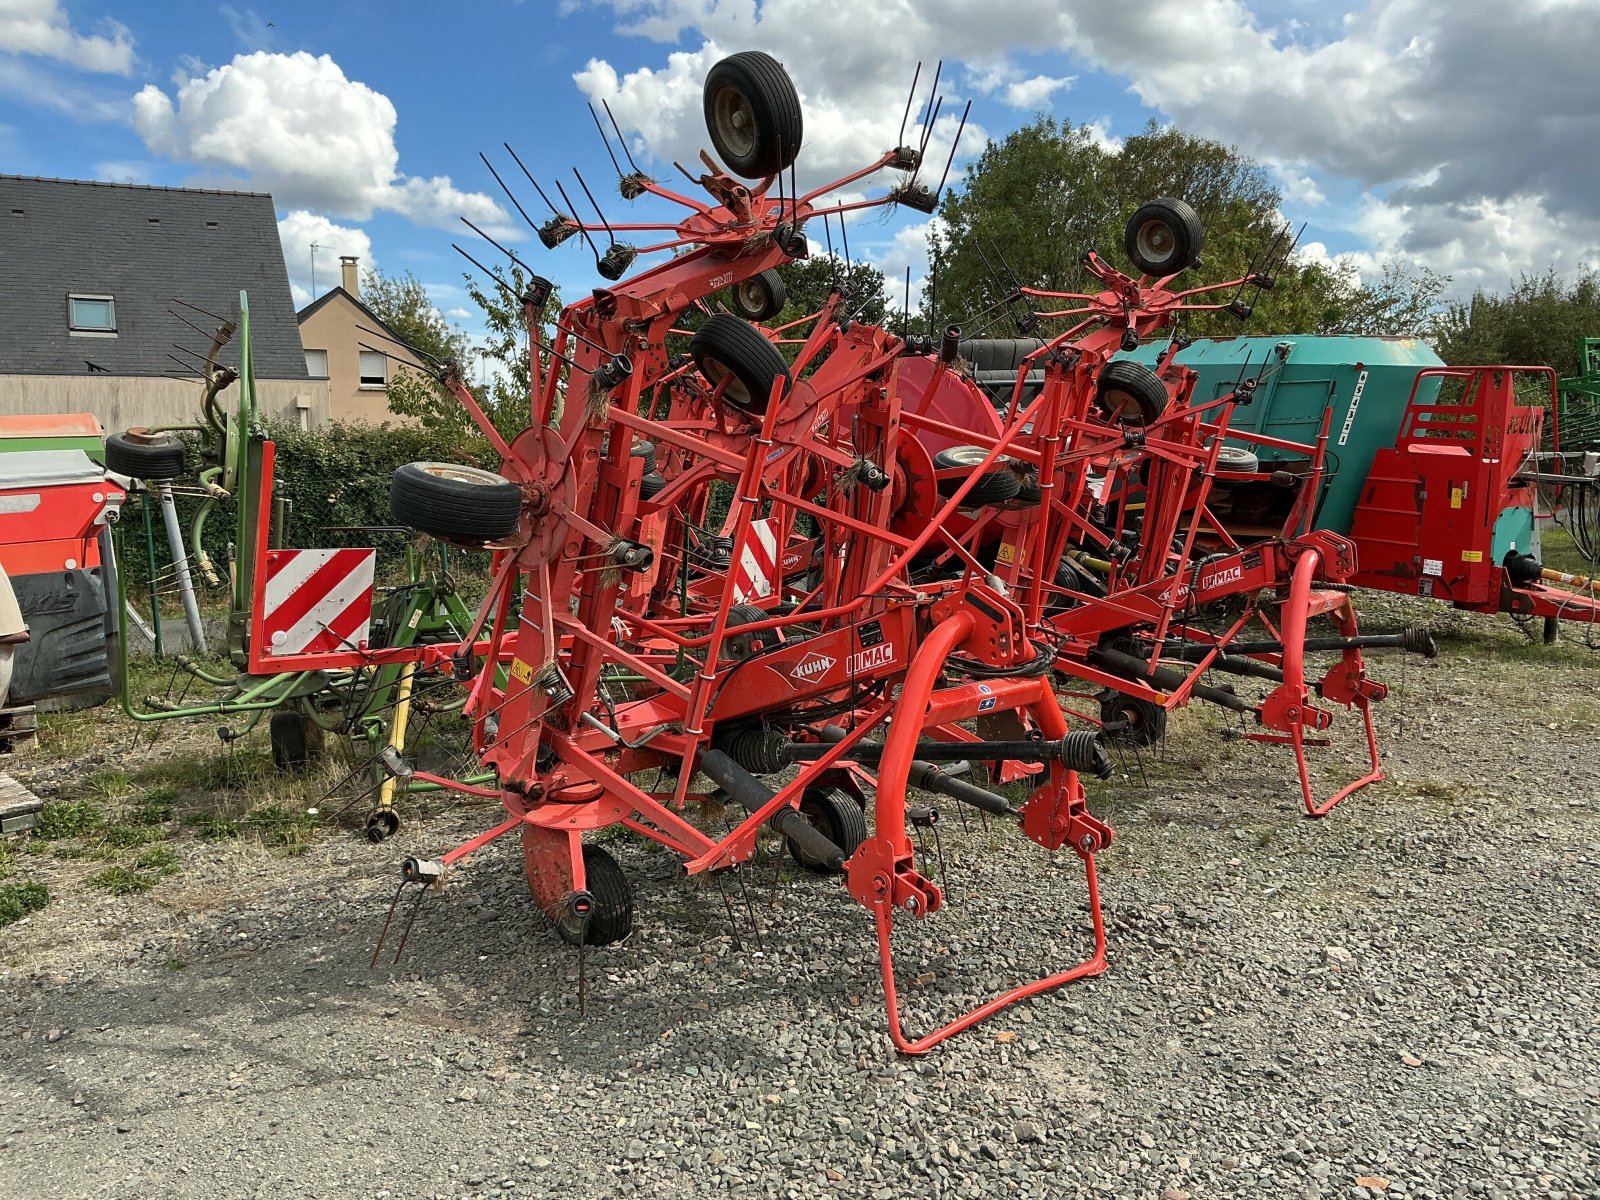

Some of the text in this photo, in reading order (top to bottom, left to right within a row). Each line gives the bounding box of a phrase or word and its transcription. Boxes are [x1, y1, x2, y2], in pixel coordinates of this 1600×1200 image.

[1360, 373, 1366, 381] 6
[1356, 386, 1362, 394] 5
[1352, 398, 1358, 407] 4
[1348, 411, 1354, 419] 3
[1344, 423, 1350, 431] 2
[1340, 435, 1346, 443] 1
[796, 657, 831, 678] KUHN
